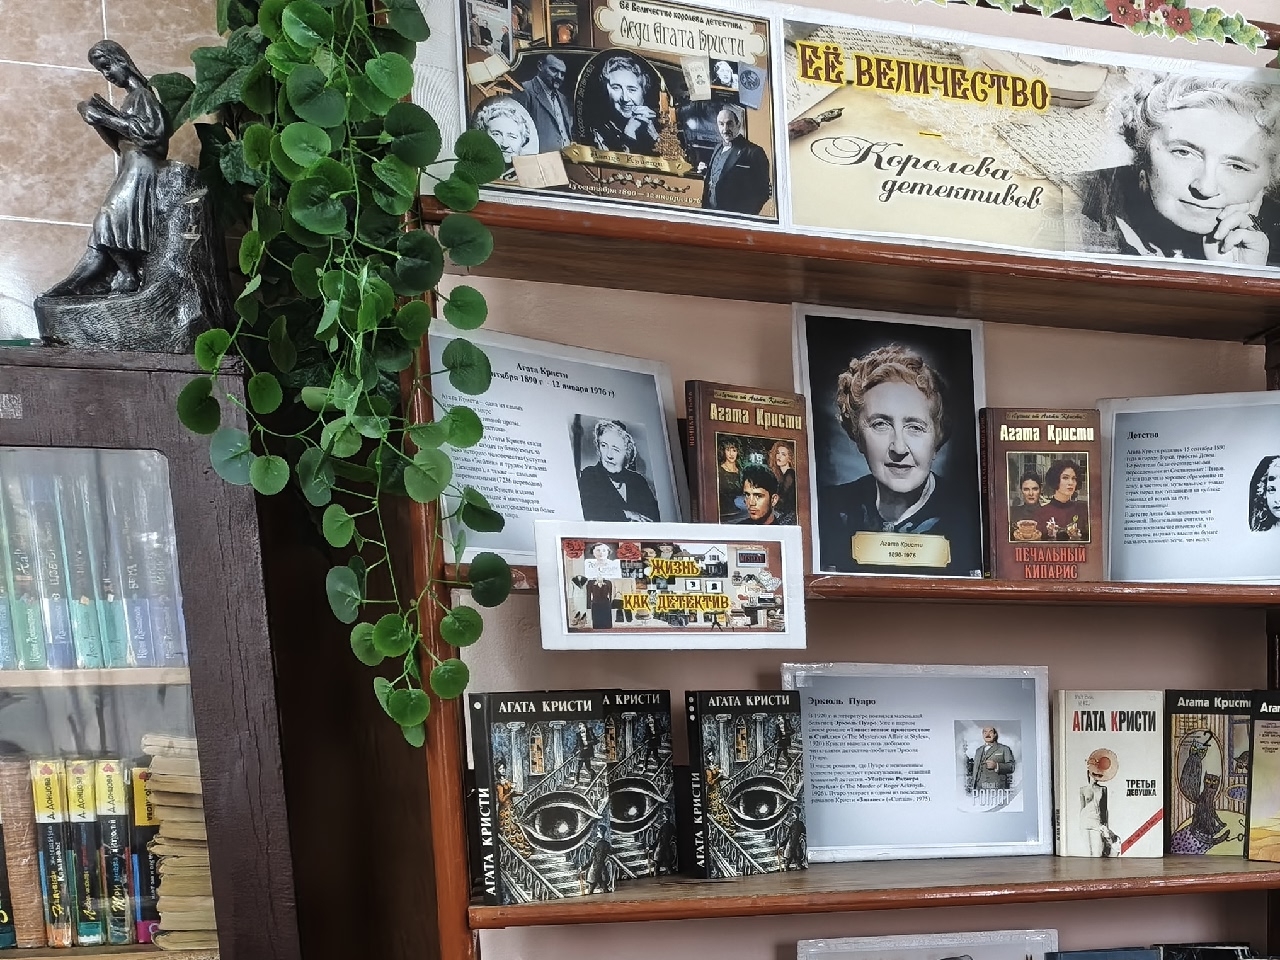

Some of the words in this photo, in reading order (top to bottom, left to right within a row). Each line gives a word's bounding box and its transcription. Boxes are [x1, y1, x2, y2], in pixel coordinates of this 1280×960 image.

[800, 43, 844, 84] ЕЁ
[854, 55, 1049, 110] ВЕЛИЧЕСТВО
[810, 136, 1013, 181] Королева
[878, 177, 1044, 210] детективов
[710, 403, 750, 424] Агата
[756, 408, 802, 430] Кристи
[1000, 424, 1040, 442] Агата
[1047, 424, 1095, 445] Кристи
[1015, 546, 1087, 563] ПЕЧАЛЬНЫЙ
[650, 559, 701, 578] ЖИЗНЬ
[1024, 564, 1079, 579] КИПАРИС
[623, 593, 650, 610] КАК
[657, 593, 730, 611] ДЕТЕКТИВ
[499, 701, 536, 713] АГАТА
[542, 700, 592, 712] КРИСТИ
[615, 694, 660, 705] КРИСТИ
[708, 696, 741, 707] АГАТА
[746, 695, 790, 705] КРИСТИ
[1177, 697, 1210, 708] Агата
[1072, 710, 1106, 732] АГАТА
[1111, 710, 1157, 732] КРИСТИ
[45, 777, 55, 811] Донцова
[106, 774, 116, 805] Донцова
[1126, 779, 1156, 788] ТРЕТЬЯ
[1126, 789, 1157, 797] ДЕВУШКА
[691, 772, 703, 824] КРИСТИ
[478, 787, 493, 846] КРИСТИ
[694, 830, 706, 868] АГАТА
[483, 853, 496, 896] АГАТА
